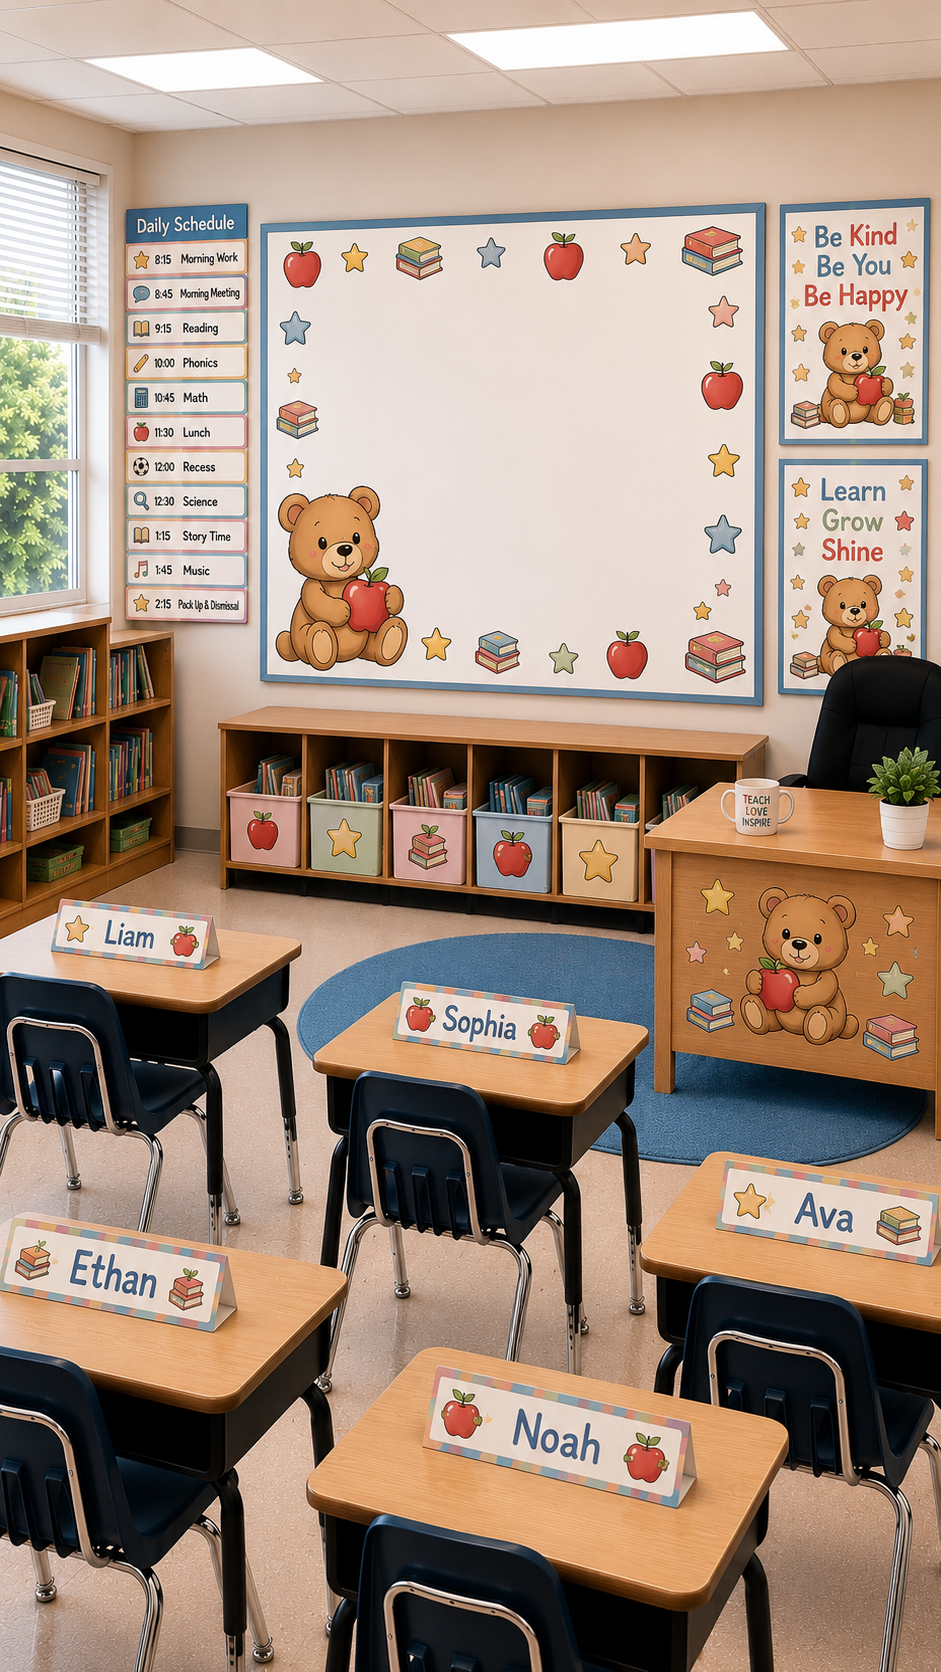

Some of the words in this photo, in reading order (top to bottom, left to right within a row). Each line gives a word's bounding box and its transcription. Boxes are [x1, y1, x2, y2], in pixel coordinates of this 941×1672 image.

[137, 218, 170, 237] Daily
[174, 214, 234, 232] Schedule
[815, 225, 842, 248] Be
[850, 222, 897, 247] Kind
[155, 255, 171, 265] 8:15
[181, 254, 214, 265] Morning
[216, 252, 238, 263] Work
[817, 255, 845, 277] Be
[852, 253, 891, 276] You
[155, 289, 173, 299] 8:45
[210, 287, 240, 299] Meeting
[804, 284, 831, 307] Be
[839, 283, 908, 312] Happy
[155, 324, 171, 333] 9:15
[183, 323, 218, 335] Reading
[154, 358, 175, 368] 10:00
[183, 358, 218, 368] Phonics
[154, 393, 174, 402] 10:45
[183, 392, 208, 402] Math
[154, 428, 174, 437] 11:30
[183, 427, 210, 437] Lunch
[154, 462, 174, 472] 12:00
[183, 462, 215, 472] Recess
[821, 478, 886, 501] Learn
[154, 497, 174, 506] 12:30
[183, 496, 218, 507] Science
[822, 508, 883, 532] Grow
[155, 531, 170, 541] 1:15
[183, 531, 207, 544] Story
[210, 531, 231, 541] Time
[821, 538, 883, 562] Shine
[155, 565, 172, 575] 1:45
[183, 565, 210, 576] Music
[155, 599, 171, 609] 2:15
[178, 599, 193, 609] Pack
[195, 600, 203, 612] Up
[204, 600, 209, 609] &
[211, 600, 239, 610] Dismissal
[743, 795, 770, 804] TEACH
[746, 807, 768, 816] LOVE
[742, 818, 771, 827] INSPIRE
[104, 919, 154, 949] Liam
[443, 1005, 516, 1042] Sophia
[794, 1192, 853, 1233] Ava
[70, 1249, 157, 1298] Ethan
[513, 1409, 600, 1464] Noah
